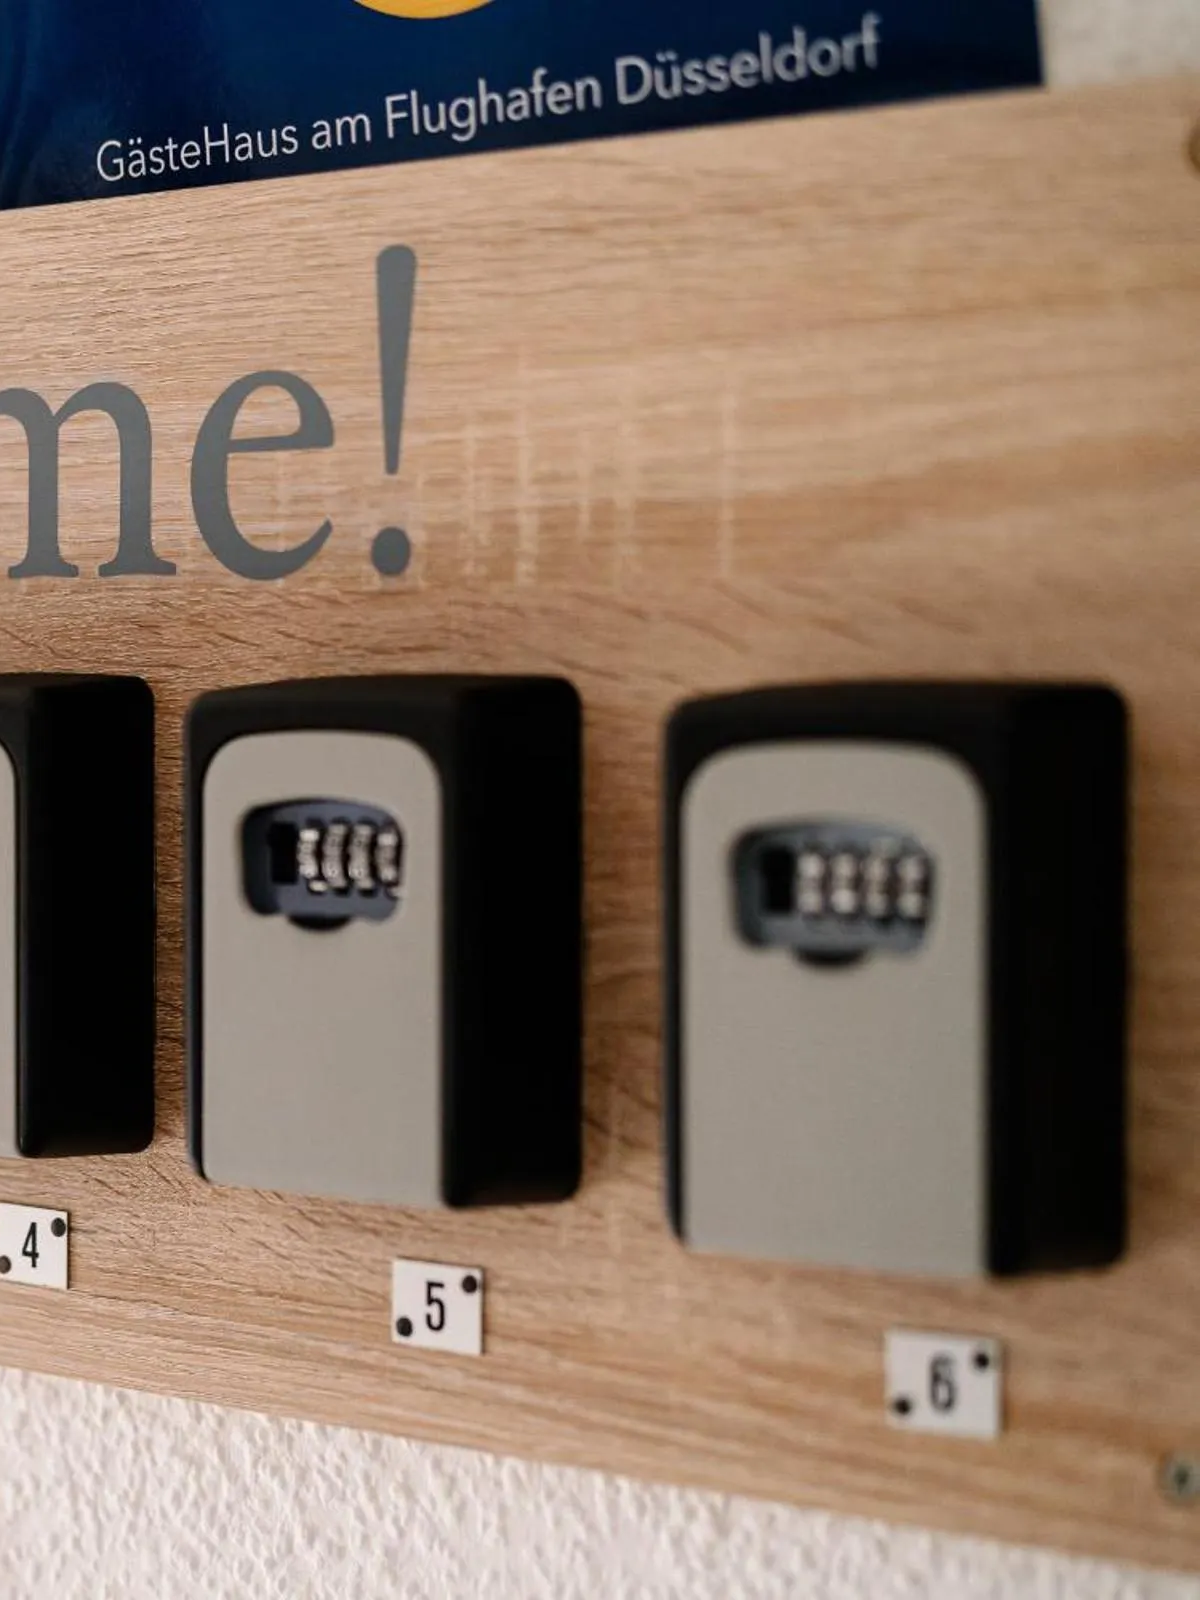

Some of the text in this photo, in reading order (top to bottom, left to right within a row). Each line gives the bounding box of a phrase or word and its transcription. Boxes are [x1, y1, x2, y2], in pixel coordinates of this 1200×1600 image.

[96, 12, 882, 182] GästeHaus am Flughafen Düsseldorf
[22, 1221, 40, 1269] 4
[426, 1281, 445, 1332] 5
[928, 1352, 957, 1416] 6
